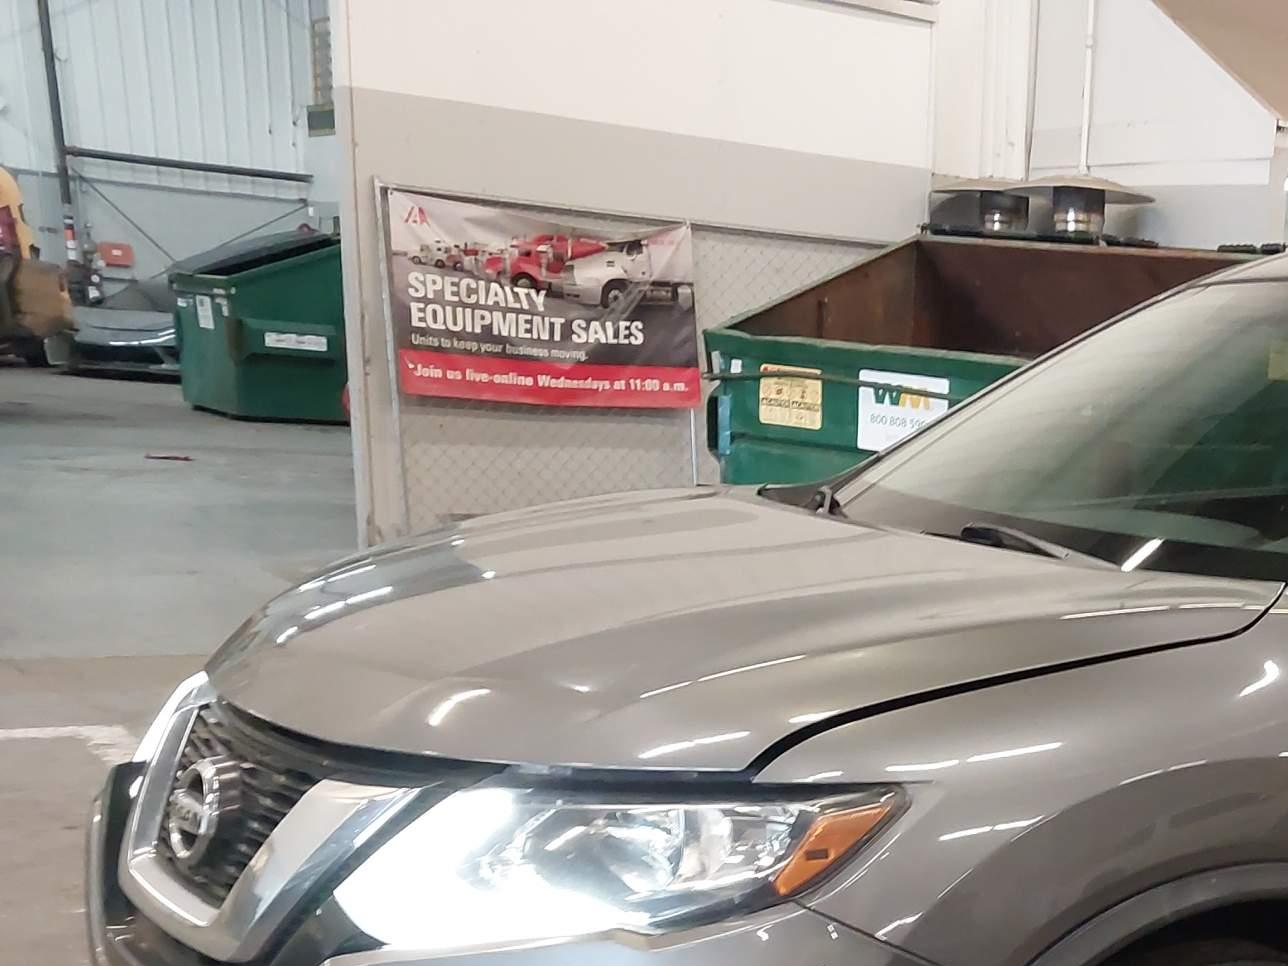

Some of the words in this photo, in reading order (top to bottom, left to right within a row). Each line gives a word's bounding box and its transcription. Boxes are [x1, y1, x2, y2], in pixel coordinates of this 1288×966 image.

[407, 271, 547, 312] SPECIALTY
[410, 302, 566, 342] EQUIPMENT
[571, 318, 645, 345] SALES
[411, 333, 440, 346] Units
[441, 337, 451, 348] to
[453, 338, 479, 352] keep
[480, 342, 503, 353] your
[505, 343, 549, 358] business
[550, 349, 589, 362] moving.
[414, 363, 443, 378] Join
[446, 369, 463, 380] us
[465, 368, 534, 387] live-online
[537, 374, 610, 392] Wednesdays
[613, 379, 626, 390] at
[662, 381, 689, 392] a.m.
[870, 413, 888, 426] 800
